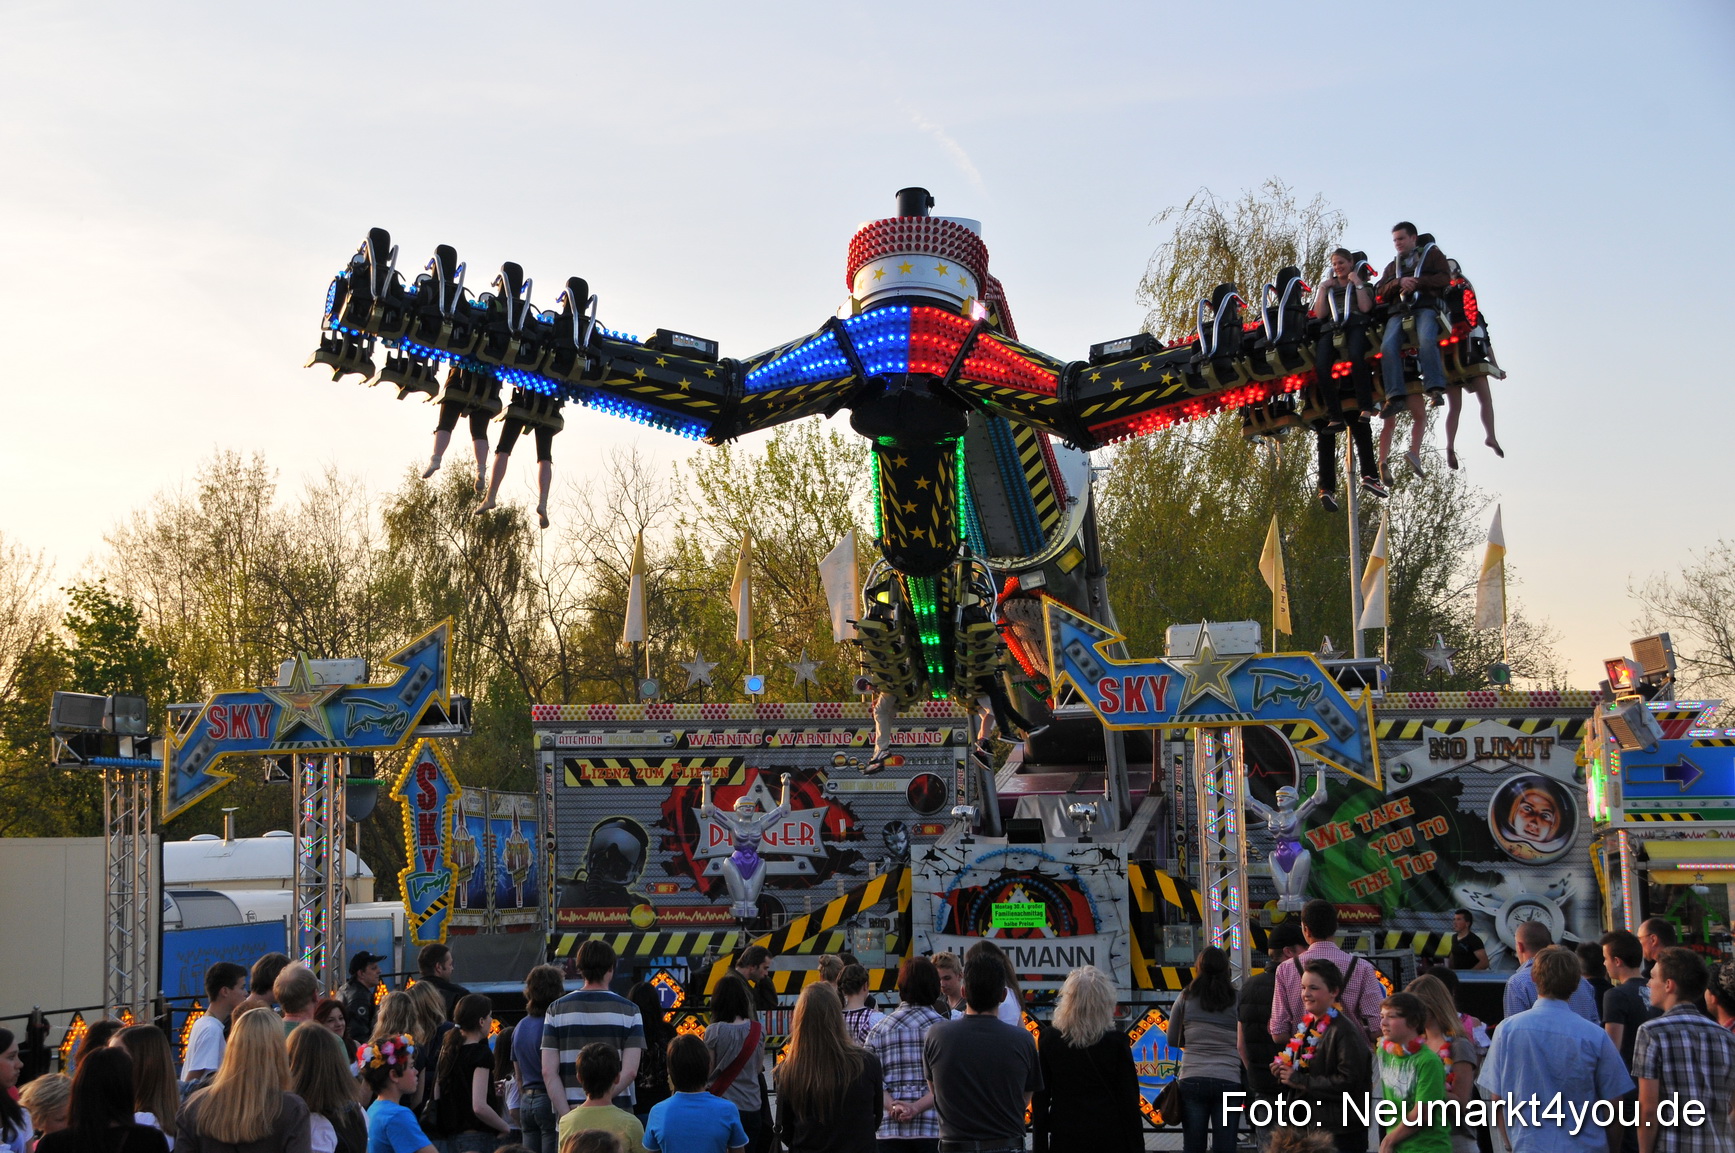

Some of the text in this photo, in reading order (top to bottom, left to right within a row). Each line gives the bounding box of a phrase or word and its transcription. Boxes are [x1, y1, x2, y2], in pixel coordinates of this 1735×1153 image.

[1097, 674, 1171, 714] SKY
[206, 703, 274, 740] SKY
[558, 735, 603, 745] ATTENTION
[687, 733, 762, 746] WARNING
[777, 732, 852, 745] WARNING
[1429, 736, 1555, 760] NO LIMIT
[580, 763, 630, 780] LIZENZ
[415, 761, 440, 873] SKY
[1305, 796, 1416, 851] WE TAKE
[709, 822, 815, 847] DGER
[1368, 815, 1449, 857] YOU TO
[1349, 851, 1438, 898] THE TOP
[657, 885, 675, 893] OFF
[947, 946, 1095, 967] HTMANN
[657, 987, 668, 1002] T
